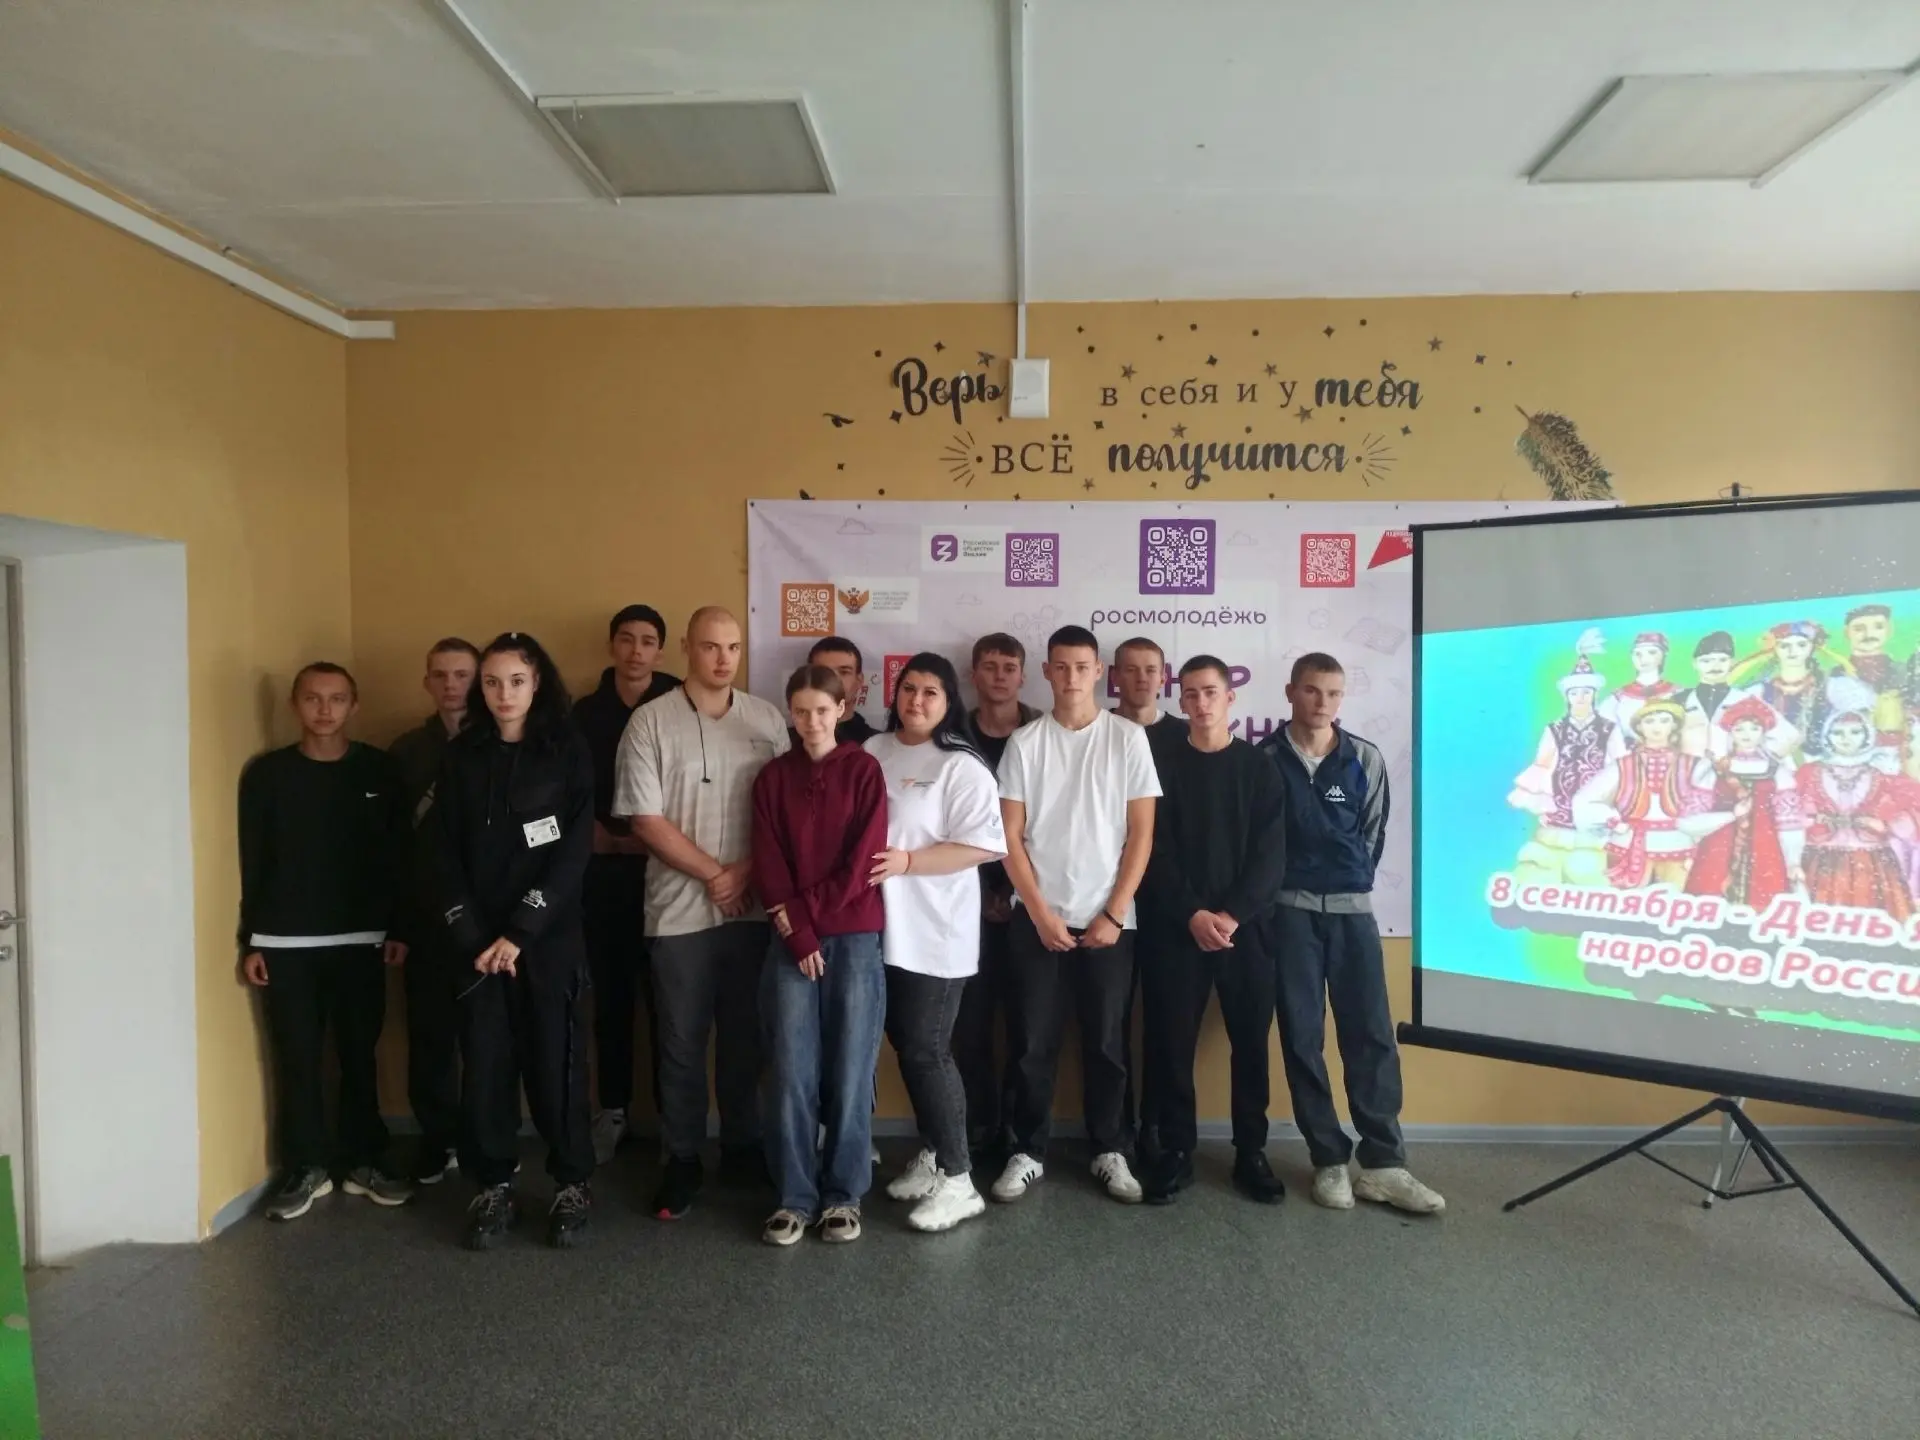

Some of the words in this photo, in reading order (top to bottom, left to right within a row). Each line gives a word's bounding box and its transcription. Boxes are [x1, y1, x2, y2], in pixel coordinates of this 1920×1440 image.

[893, 357, 1007, 425] Верь
[1100, 386, 1118, 407] в
[1140, 377, 1219, 407] себя
[1236, 383, 1258, 403] и
[1279, 380, 1298, 409] у
[1314, 360, 1424, 411] тебя
[1107, 442, 1347, 491] получится
[1091, 606, 1267, 632] росмолодёжь
[1491, 877, 1512, 901] 8
[1521, 886, 1719, 927] сентября
[1758, 899, 1893, 939] День
[1584, 937, 1763, 977] народов
[1779, 951, 1920, 998] Росси
